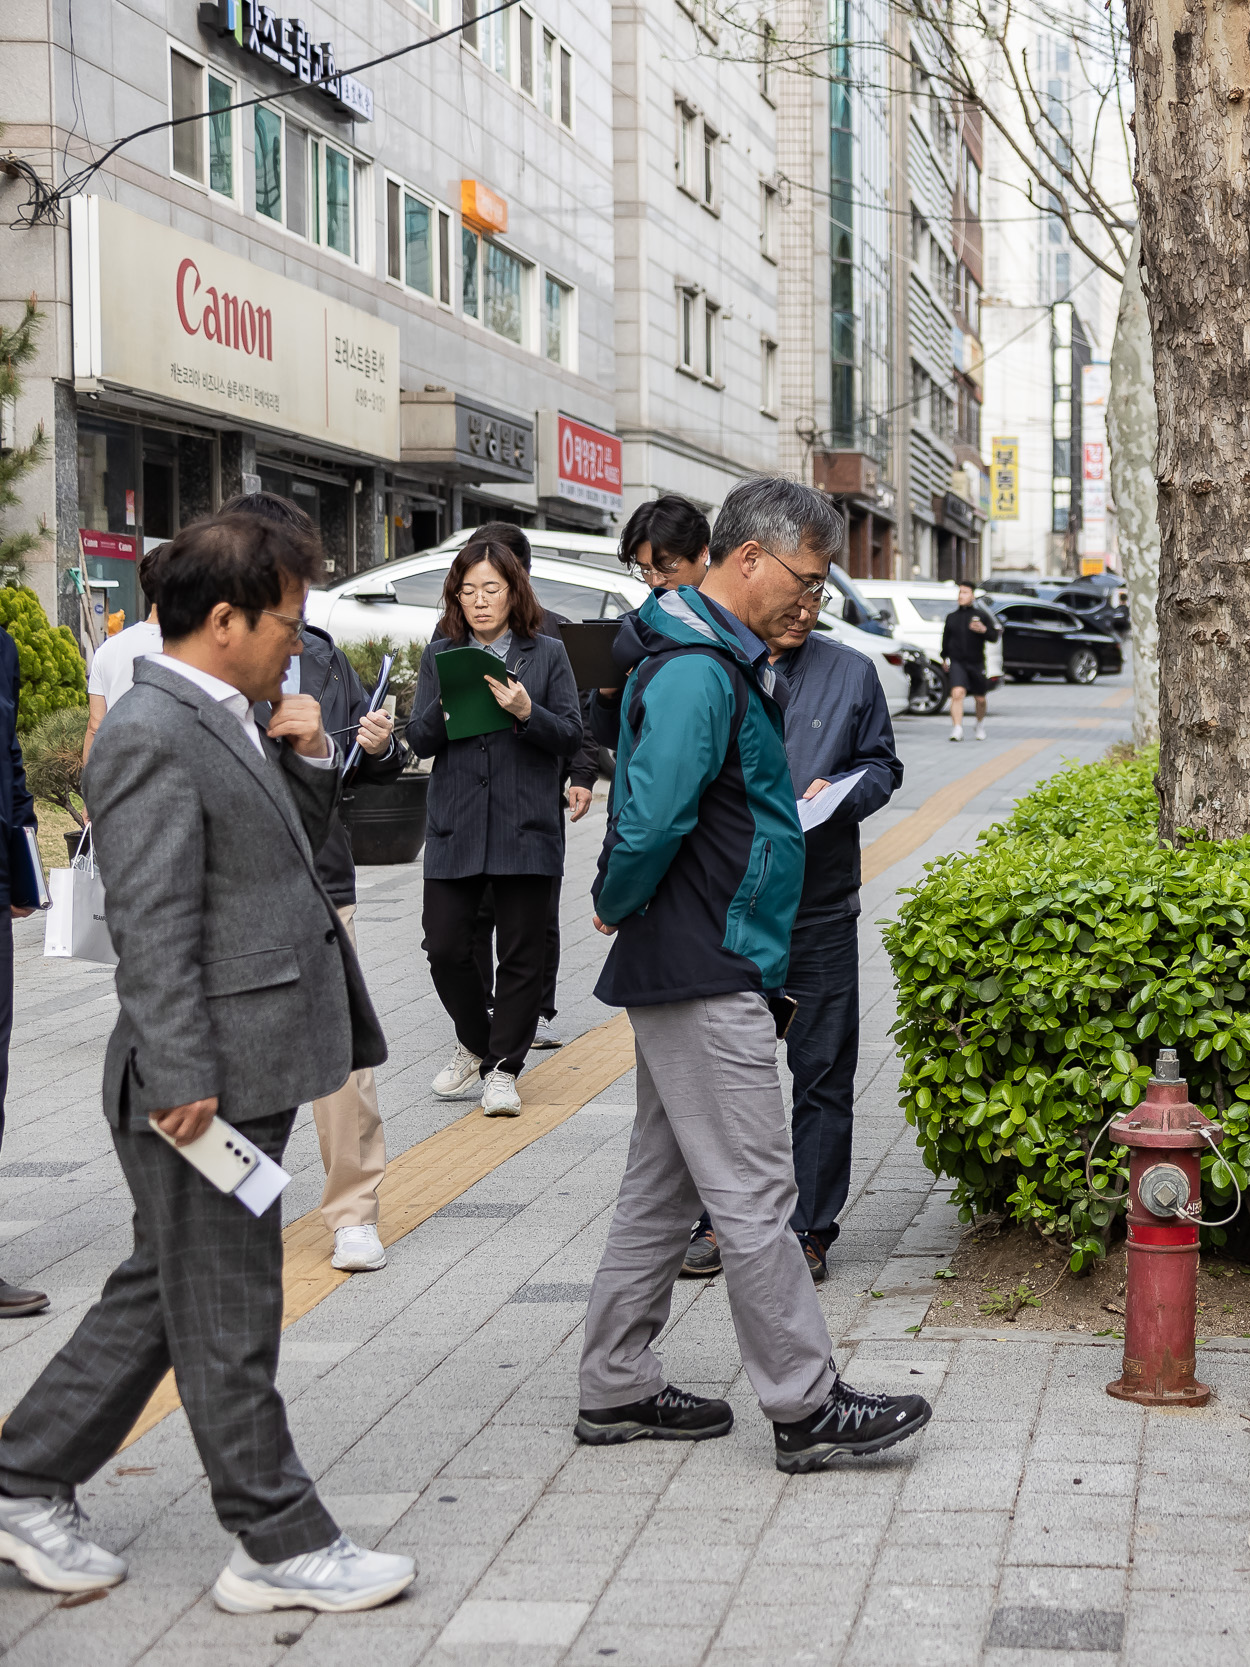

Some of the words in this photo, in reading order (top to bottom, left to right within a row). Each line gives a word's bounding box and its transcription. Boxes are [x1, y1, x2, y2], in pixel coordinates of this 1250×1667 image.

[176, 258, 273, 361] Canon
[203, 373, 226, 395] 비즈니스
[335, 336, 385, 384] 포레스트솔루션
[996, 449, 1014, 512] 부동산
